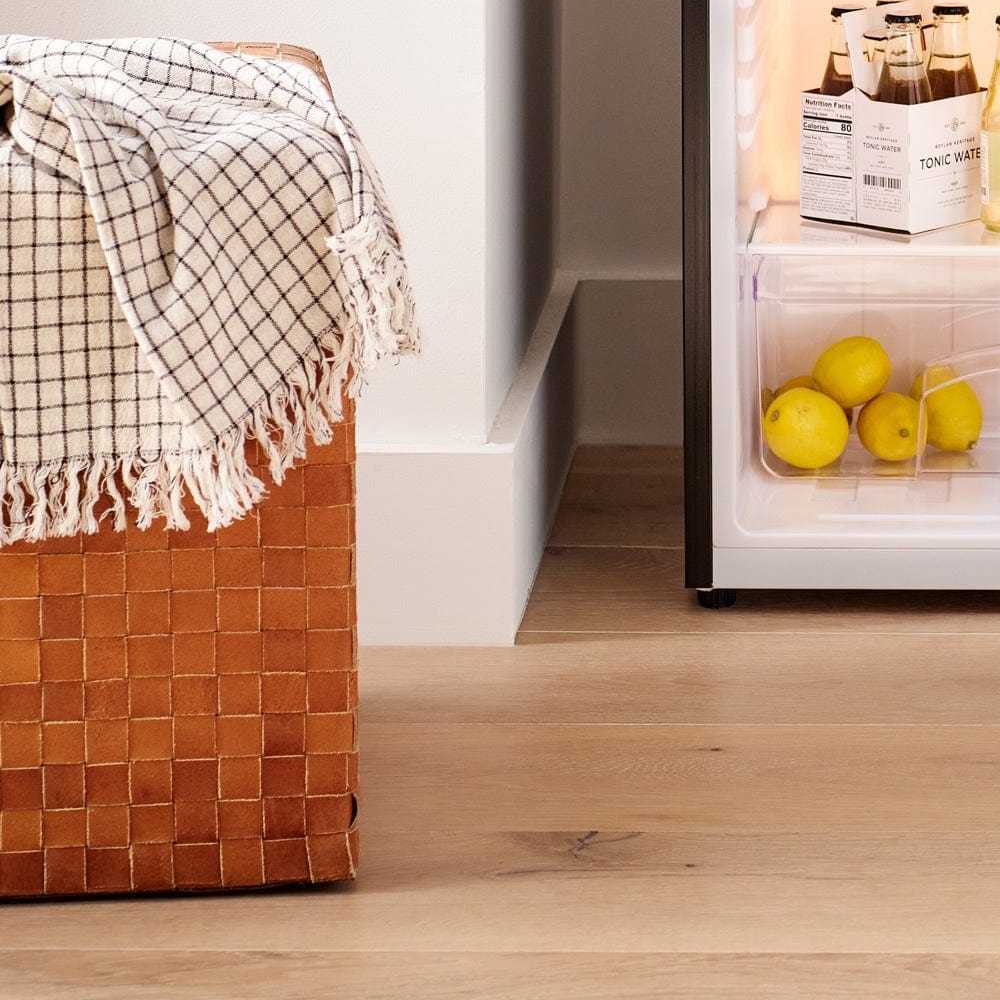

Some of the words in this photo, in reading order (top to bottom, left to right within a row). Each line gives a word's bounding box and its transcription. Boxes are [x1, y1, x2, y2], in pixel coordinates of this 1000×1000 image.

[805, 98, 832, 107] Nutrition
[833, 101, 852, 110] Facts
[803, 121, 830, 131] Calories
[840, 123, 852, 132] 80
[863, 142, 880, 150] TONIC
[881, 145, 902, 153] WATER
[919, 153, 951, 170] TONIC
[954, 147, 981, 163] WATE
